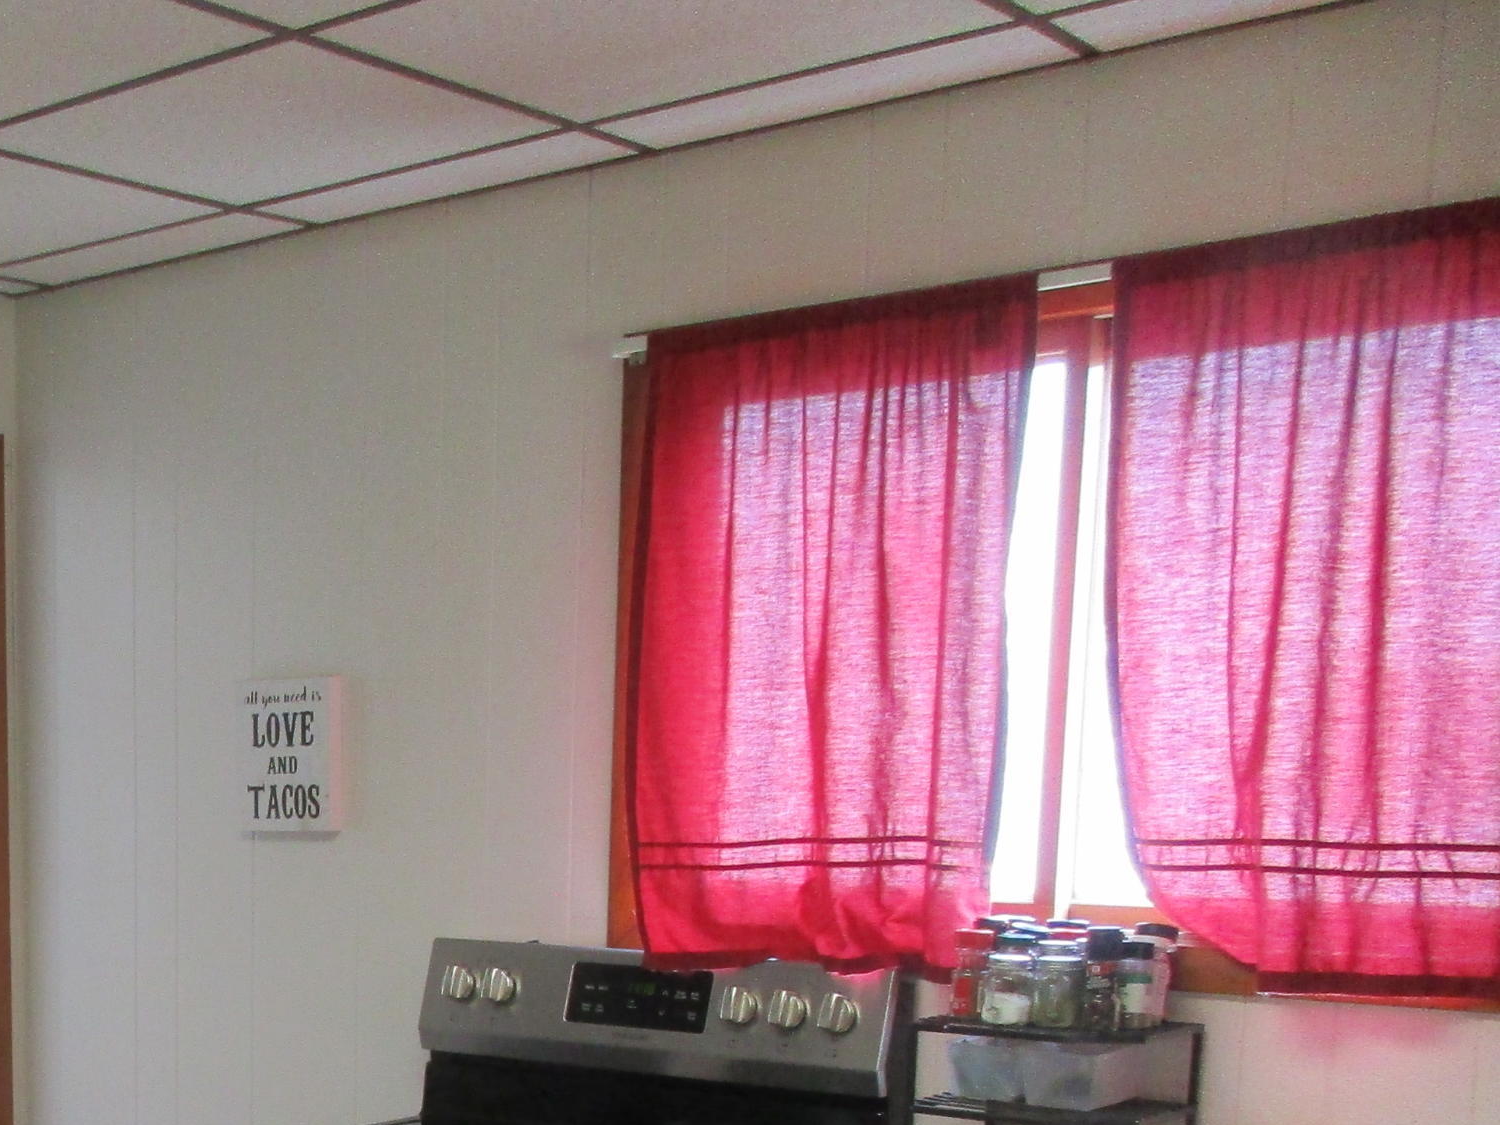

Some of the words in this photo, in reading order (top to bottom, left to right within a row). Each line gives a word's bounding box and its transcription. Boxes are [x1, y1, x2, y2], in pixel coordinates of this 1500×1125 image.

[244, 691, 258, 705] all
[262, 695, 280, 708] you
[284, 686, 307, 704] need
[311, 690, 322, 701] is
[252, 711, 314, 748] LOVE
[268, 755, 298, 775] AND
[247, 784, 321, 819] TACOS
